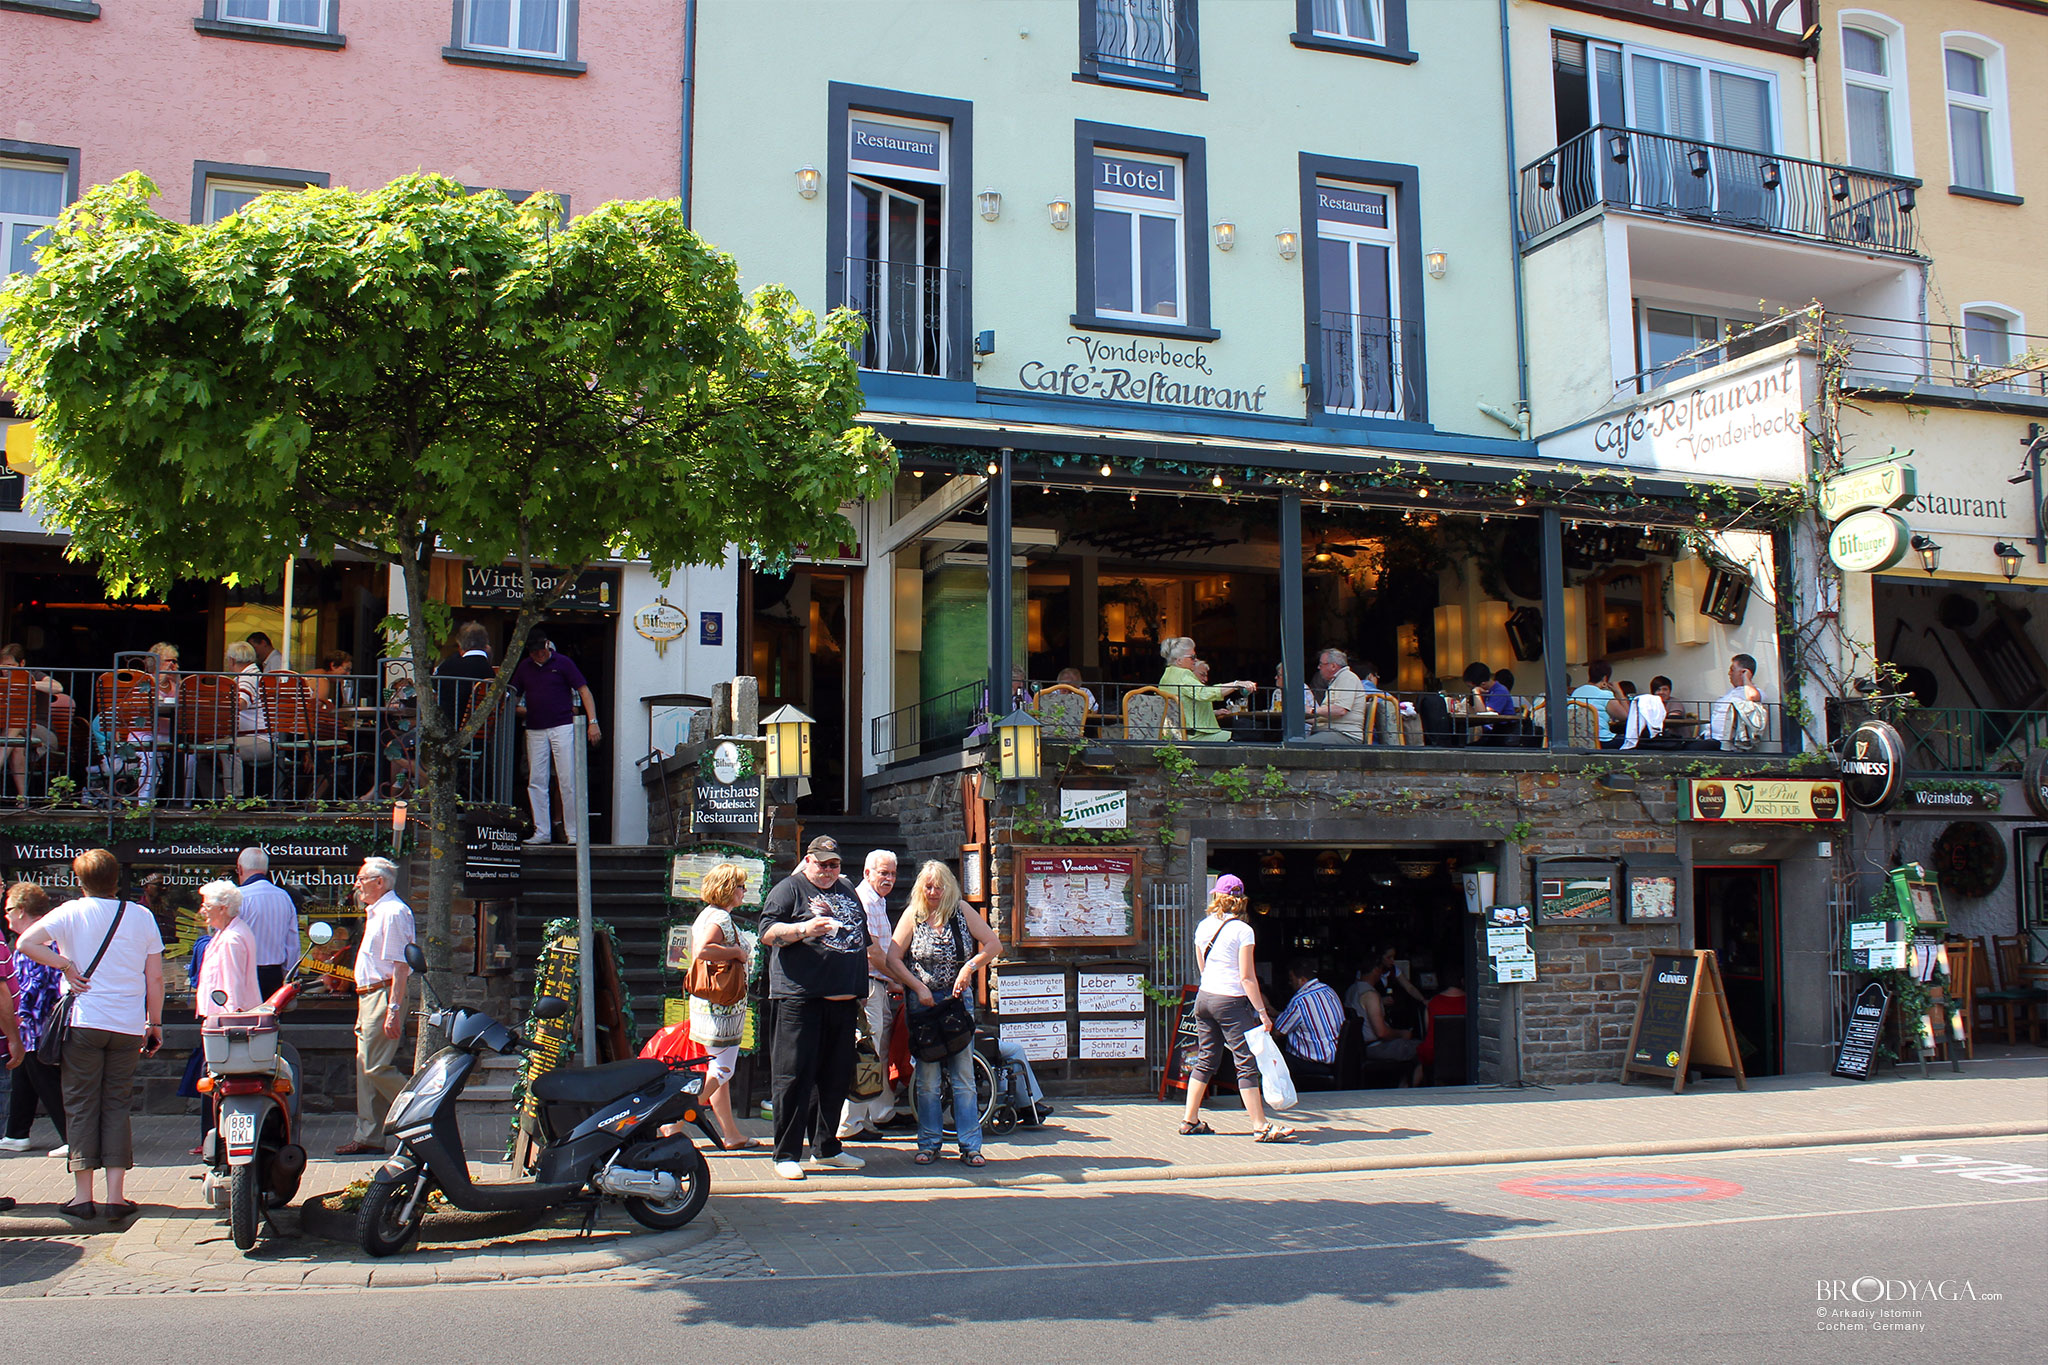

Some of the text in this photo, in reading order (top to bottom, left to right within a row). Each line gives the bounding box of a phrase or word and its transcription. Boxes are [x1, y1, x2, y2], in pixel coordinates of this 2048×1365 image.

[856, 130, 934, 155] Restaurant
[1102, 162, 1165, 192] Hotel
[1319, 194, 1384, 215] Restaurant
[1067, 336, 1213, 375] Vonderbeck
[1676, 408, 1801, 462] Vonderbeck
[1838, 533, 1886, 557] Bitburger
[642, 614, 682, 630] Bitburger
[1840, 759, 1888, 776] GUINNESS
[697, 785, 759, 799] Wirtshaus
[1769, 783, 1798, 799] Pint
[1916, 791, 1973, 805] Weinstube
[709, 799, 756, 810] Dudelsack
[1699, 795, 1724, 803] GUINNESS
[696, 810, 758, 823] Restaurant
[1063, 797, 1126, 823] Zimmer
[1105, 818, 1125, 827] 1890
[477, 826, 517, 841] Wirtshaus
[171, 846, 222, 855] Dudelsack
[1061, 858, 1099, 873] Vonderbeck
[139, 872, 157, 886] ZUM
[671, 936, 687, 946] Grill
[1081, 976, 1117, 988] Leber
[1658, 972, 1688, 985] GUINNESS
[1023, 1005, 1050, 1014] Apfelmus
[1856, 1005, 1881, 1017] GUINNESS
[1002, 1021, 1046, 1031] Puten-Steak
[1091, 1041, 1127, 1049] Schnitzel
[1091, 1049, 1126, 1057] Paradies
[231, 1116, 253, 1129] 889
[597, 1110, 630, 1127] CORDI
[231, 1130, 251, 1141] RKL
